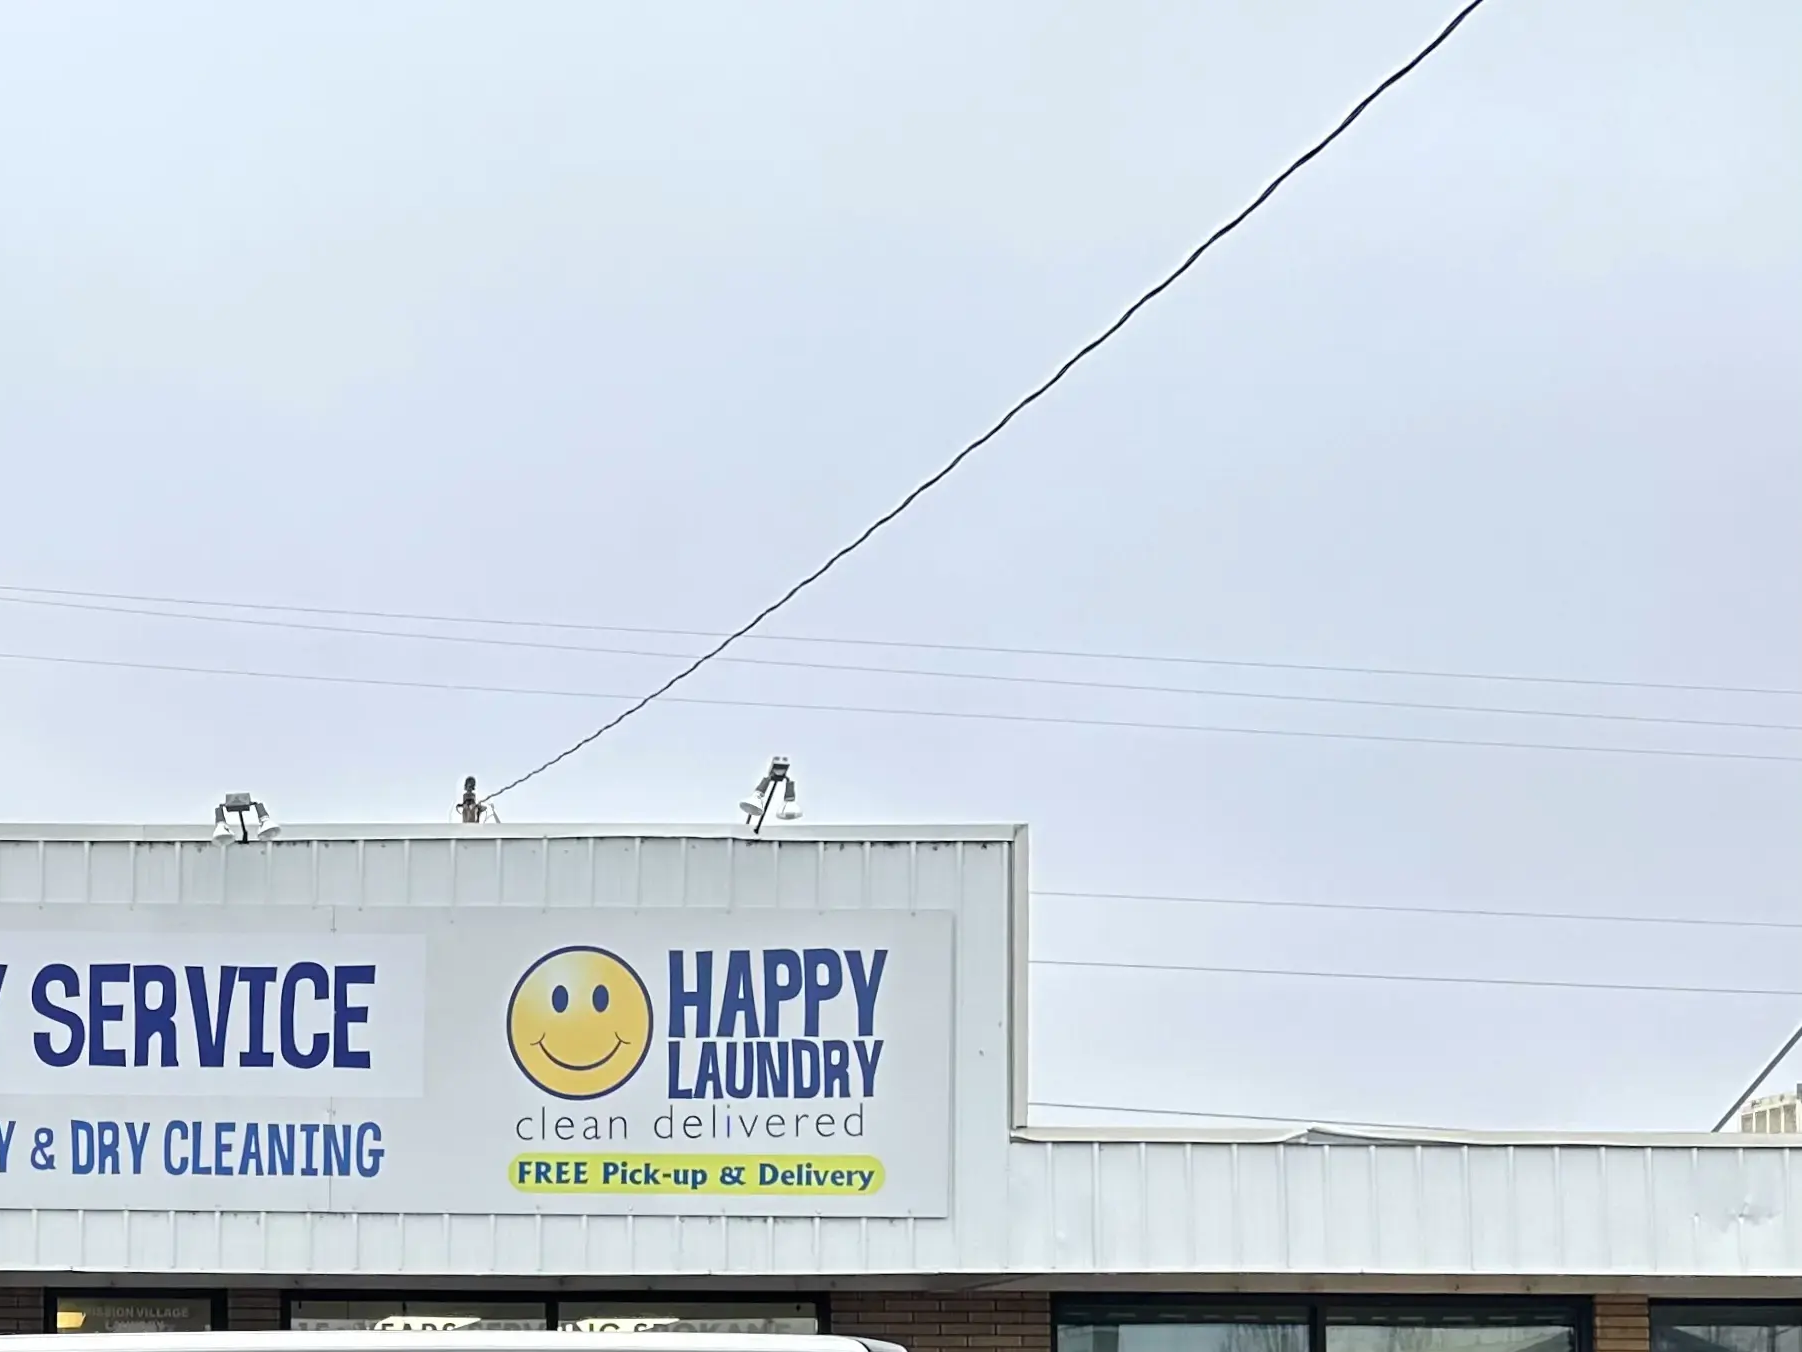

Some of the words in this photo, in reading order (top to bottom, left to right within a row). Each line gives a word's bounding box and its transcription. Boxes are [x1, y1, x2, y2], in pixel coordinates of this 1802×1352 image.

[31, 961, 377, 1069] SERVICE
[668, 948, 889, 1038] HAPPY
[668, 1039, 884, 1100] LAUNDRY
[30, 1126, 55, 1171] &
[71, 1119, 151, 1175] DRY
[164, 1120, 386, 1178] CLEANING
[515, 1106, 629, 1140] clean
[653, 1103, 864, 1138] delivered
[517, 1161, 589, 1184] FREE
[602, 1160, 708, 1190] Pick-up
[719, 1166, 747, 1186] &
[758, 1163, 875, 1191] Delivery
[137, 1307, 189, 1318] VILLAGE
